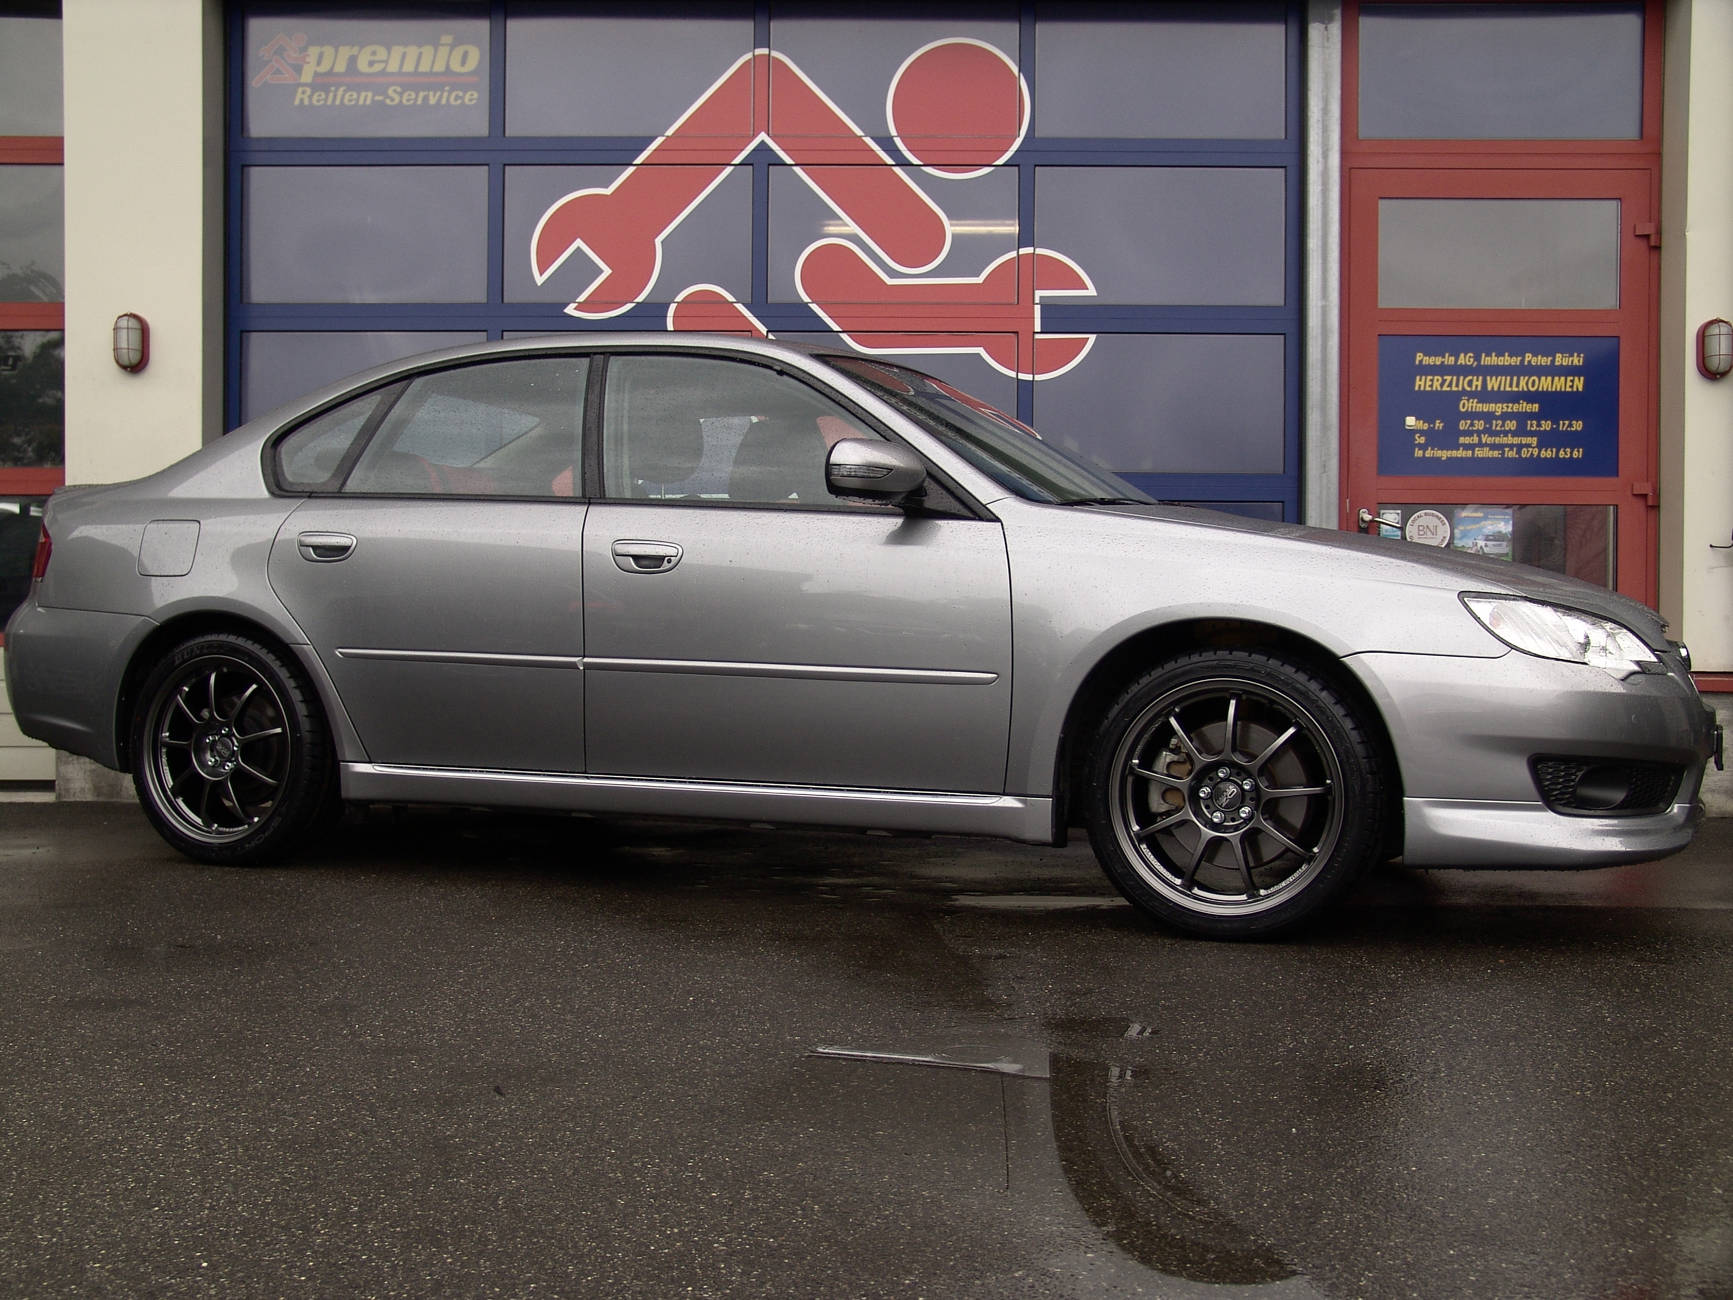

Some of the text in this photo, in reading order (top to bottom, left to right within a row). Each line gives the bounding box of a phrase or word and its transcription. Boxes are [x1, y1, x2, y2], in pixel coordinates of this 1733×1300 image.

[300, 34, 481, 83] premio
[293, 86, 479, 106] Reifen-Service
[1415, 352, 1584, 368] Pneu-In AG, Inhaber Peter Bürki
[1414, 375, 1584, 392] HERZLICH WILLKOMMEN
[1459, 397, 1539, 415] Öffnungszeiten
[1435, 420, 1444, 430] Fr
[1459, 420, 1485, 431] 07.30
[1492, 420, 1517, 431] 12.00
[1526, 420, 1552, 431] 13.30
[1558, 420, 1583, 431] 17.30
[1459, 434, 1479, 444] nach
[1481, 434, 1538, 447] Vereinbarung
[1414, 447, 1583, 460] In dringenden Fällen: Tel. 079 661 63 61
[1417, 524, 1438, 536] BNI
